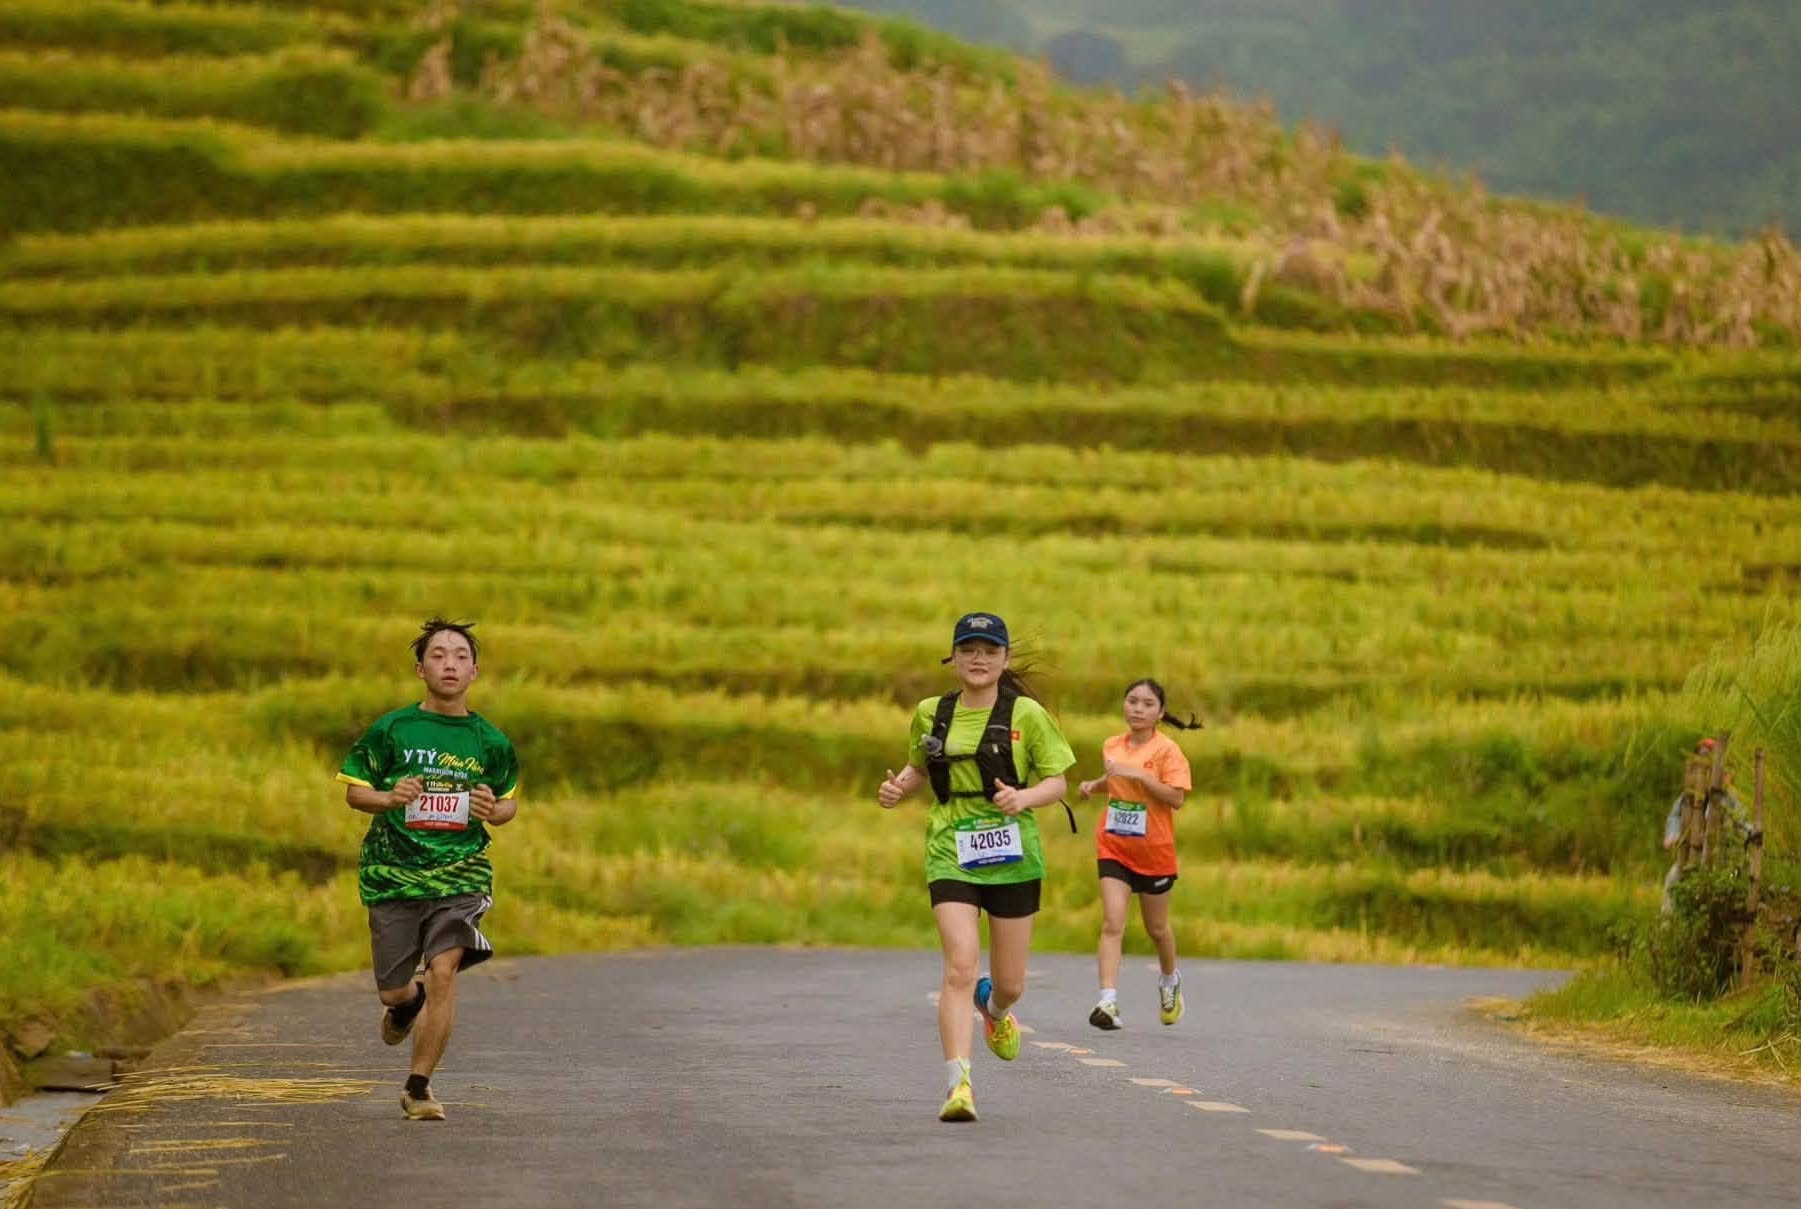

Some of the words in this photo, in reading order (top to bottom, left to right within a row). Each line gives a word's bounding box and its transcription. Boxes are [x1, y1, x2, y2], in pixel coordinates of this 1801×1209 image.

[403, 749, 413, 764] Y
[420, 795, 460, 812] 21037
[970, 829, 1011, 851] 42035
